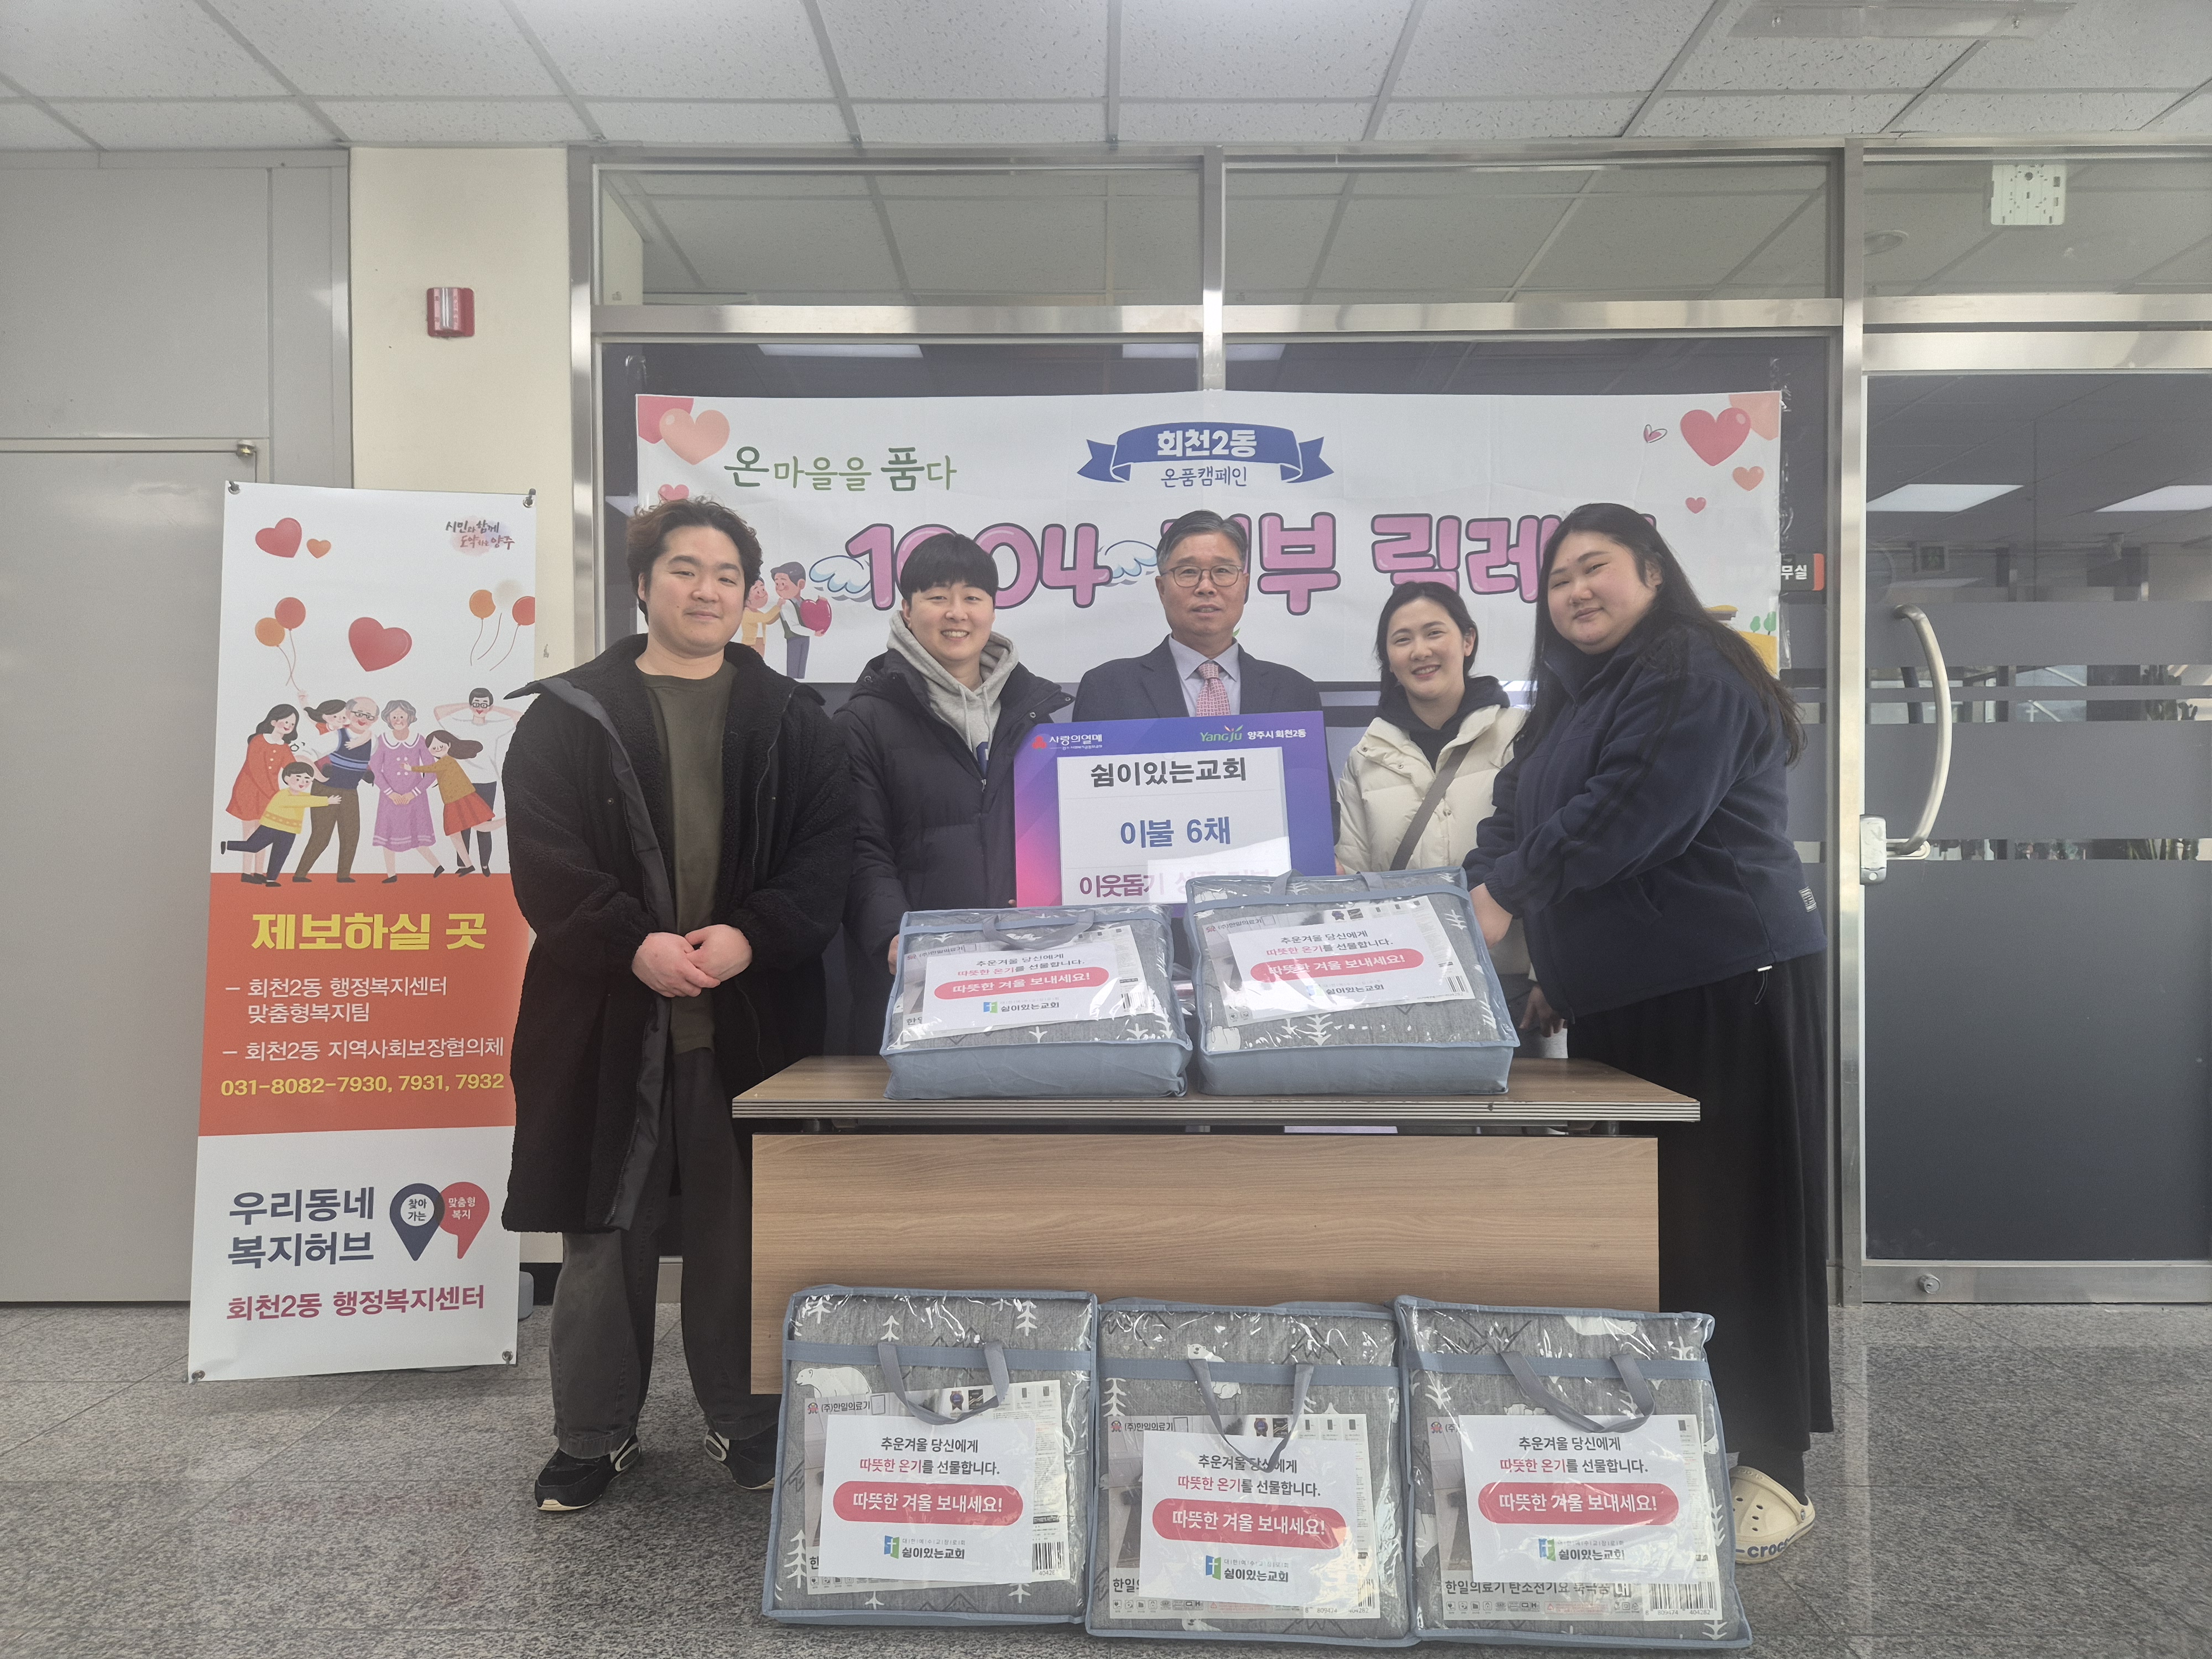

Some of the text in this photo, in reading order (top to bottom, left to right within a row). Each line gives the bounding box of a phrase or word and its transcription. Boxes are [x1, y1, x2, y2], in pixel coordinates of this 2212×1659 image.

[1157, 429, 1257, 457] 회천2동
[1161, 466, 1246, 487] 온품캠페인
[445, 520, 499, 534] 시민과 함께
[491, 534, 515, 550] 양주
[1371, 513, 1657, 603] 릴레
[1781, 565, 1807, 580] 무실
[1049, 734, 1102, 746] 사랑의열매
[1248, 729, 1307, 740] 양주시 회천2동
[1091, 757, 1246, 787] 쉼이있는교회
[1120, 816, 1230, 848] 이불 6채
[1079, 873, 1164, 898] 이웃돕기
[251, 912, 487, 950] 제보하실 곳
[1218, 919, 1262, 930] (주)한일의료기
[1280, 930, 1368, 944] 추운겨울 당신에게
[1266, 946, 1298, 956] 따뜻한
[1337, 938, 1393, 951] 선물합니다.
[976, 953, 1064, 967] 추운겨울 당신에게
[1313, 961, 1342, 971] 겨울
[1345, 954, 1406, 968] 보내세요!
[957, 969, 990, 977] 따뜻한
[1029, 961, 1085, 971] 선물합니다.
[248, 977, 447, 998] 회천2동 행정복지센터
[953, 972, 1091, 993] 따뜻한 겨울 보내세요!
[248, 1003, 369, 1024] 맞춤형복지팀
[245, 1037, 504, 1061] 회천2동 지역사회보장협의체
[221, 1073, 504, 1095] 031-8082-7930, 7931, 7932
[229, 1187, 374, 1225] 우리동네
[408, 1198, 427, 1209] 찾아
[448, 1197, 476, 1208] 맞춤형
[408, 1211, 426, 1222] 가는
[452, 1209, 471, 1220] 복지
[228, 1232, 374, 1269] 복지허브
[227, 1285, 483, 1321] 회천2동 행정복지센터
[821, 1401, 870, 1412] (주)한일의료기
[1124, 1421, 1173, 1432] (주)한일의료기
[881, 1437, 978, 1453] 추운겨울 당신에게
[1519, 1437, 1621, 1452] 추운겨울 당신에게
[860, 1458, 1000, 1475] 따뜻한 온기를 선물합니다.
[1198, 1454, 1246, 1471] 추운겨울
[1500, 1458, 1648, 1474] 따뜻한 온기를 선물합니다.
[1178, 1475, 1321, 1497] 따뜻한 온기를 선물합니다.
[853, 1491, 1003, 1514] 따뜻한 겨울 보내세요!
[1499, 1493, 1657, 1512] 따뜻한 겨울 보내세요!
[1172, 1510, 1325, 1536] 따뜻한 겨울 보내세요!
[901, 1547, 965, 1559] 쉼이있는교회
[1558, 1549, 1625, 1561] 쉼이있는교회
[1224, 1568, 1288, 1583] 쉼이있는교회
[1445, 1580, 1505, 1594] 한일의료기
[1509, 1582, 1570, 1595] 탄소전기요
